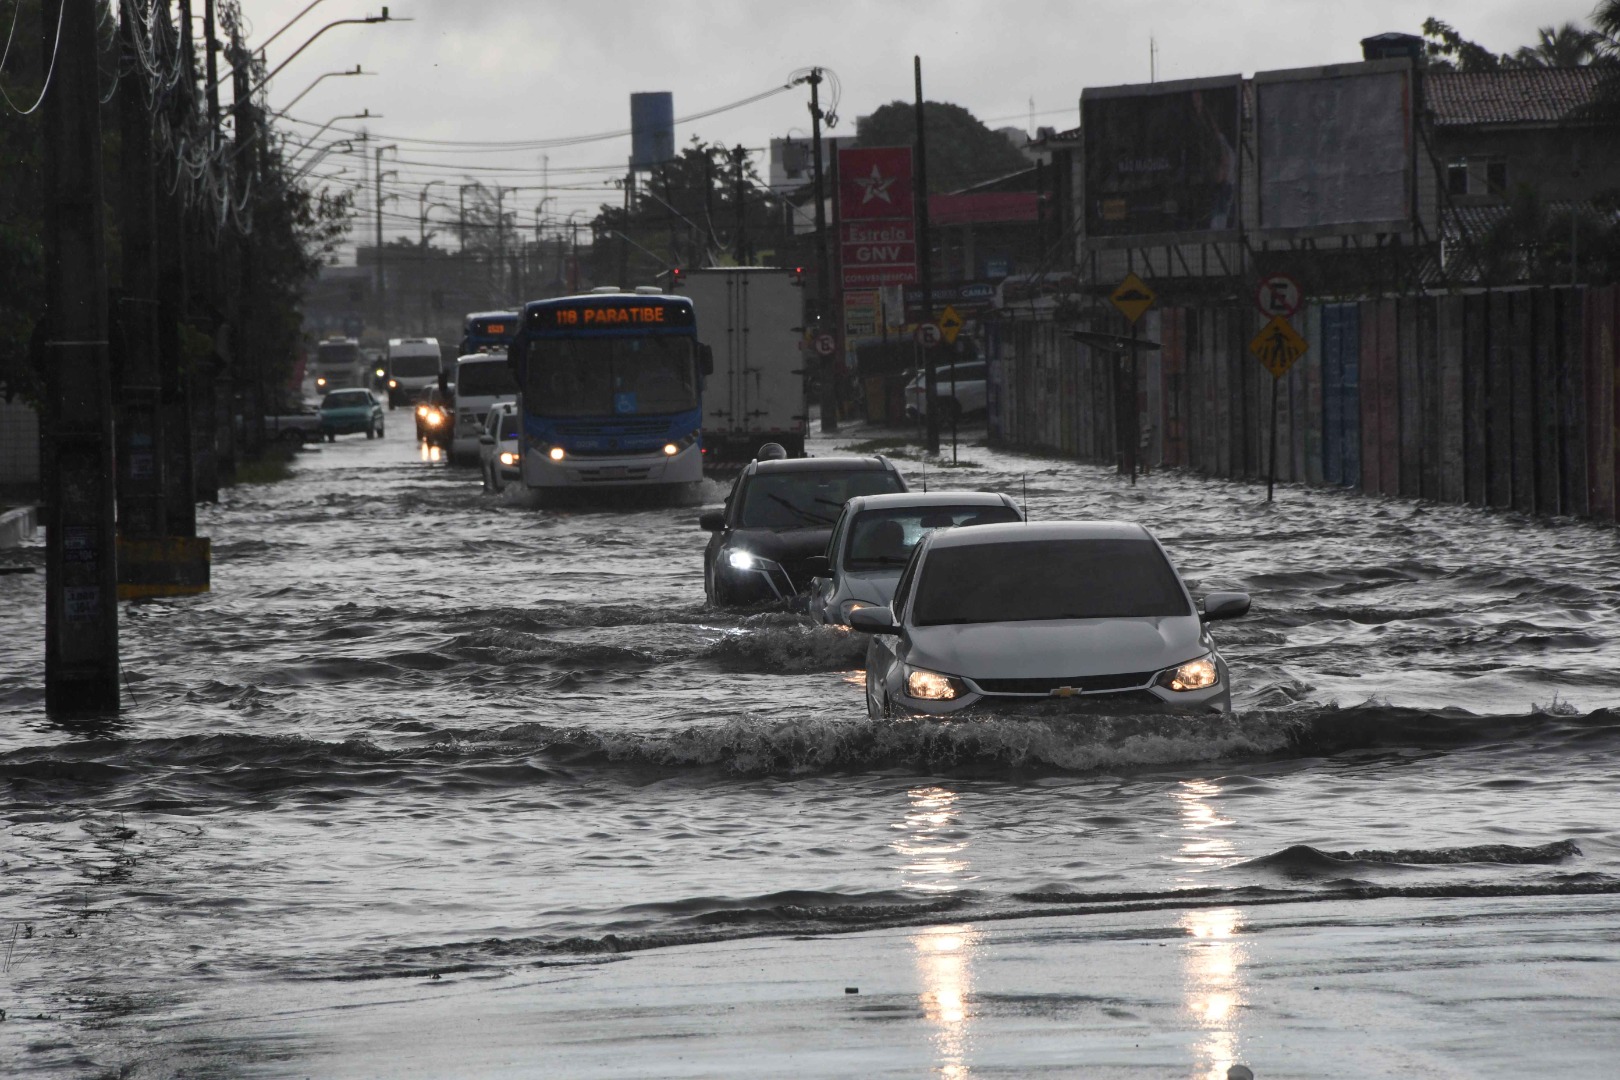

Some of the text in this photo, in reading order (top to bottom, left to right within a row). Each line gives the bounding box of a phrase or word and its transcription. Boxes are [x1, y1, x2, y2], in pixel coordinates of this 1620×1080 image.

[849, 223, 907, 241] Estrela
[856, 246, 900, 262] GNV
[584, 307, 664, 323] PARATIBE
